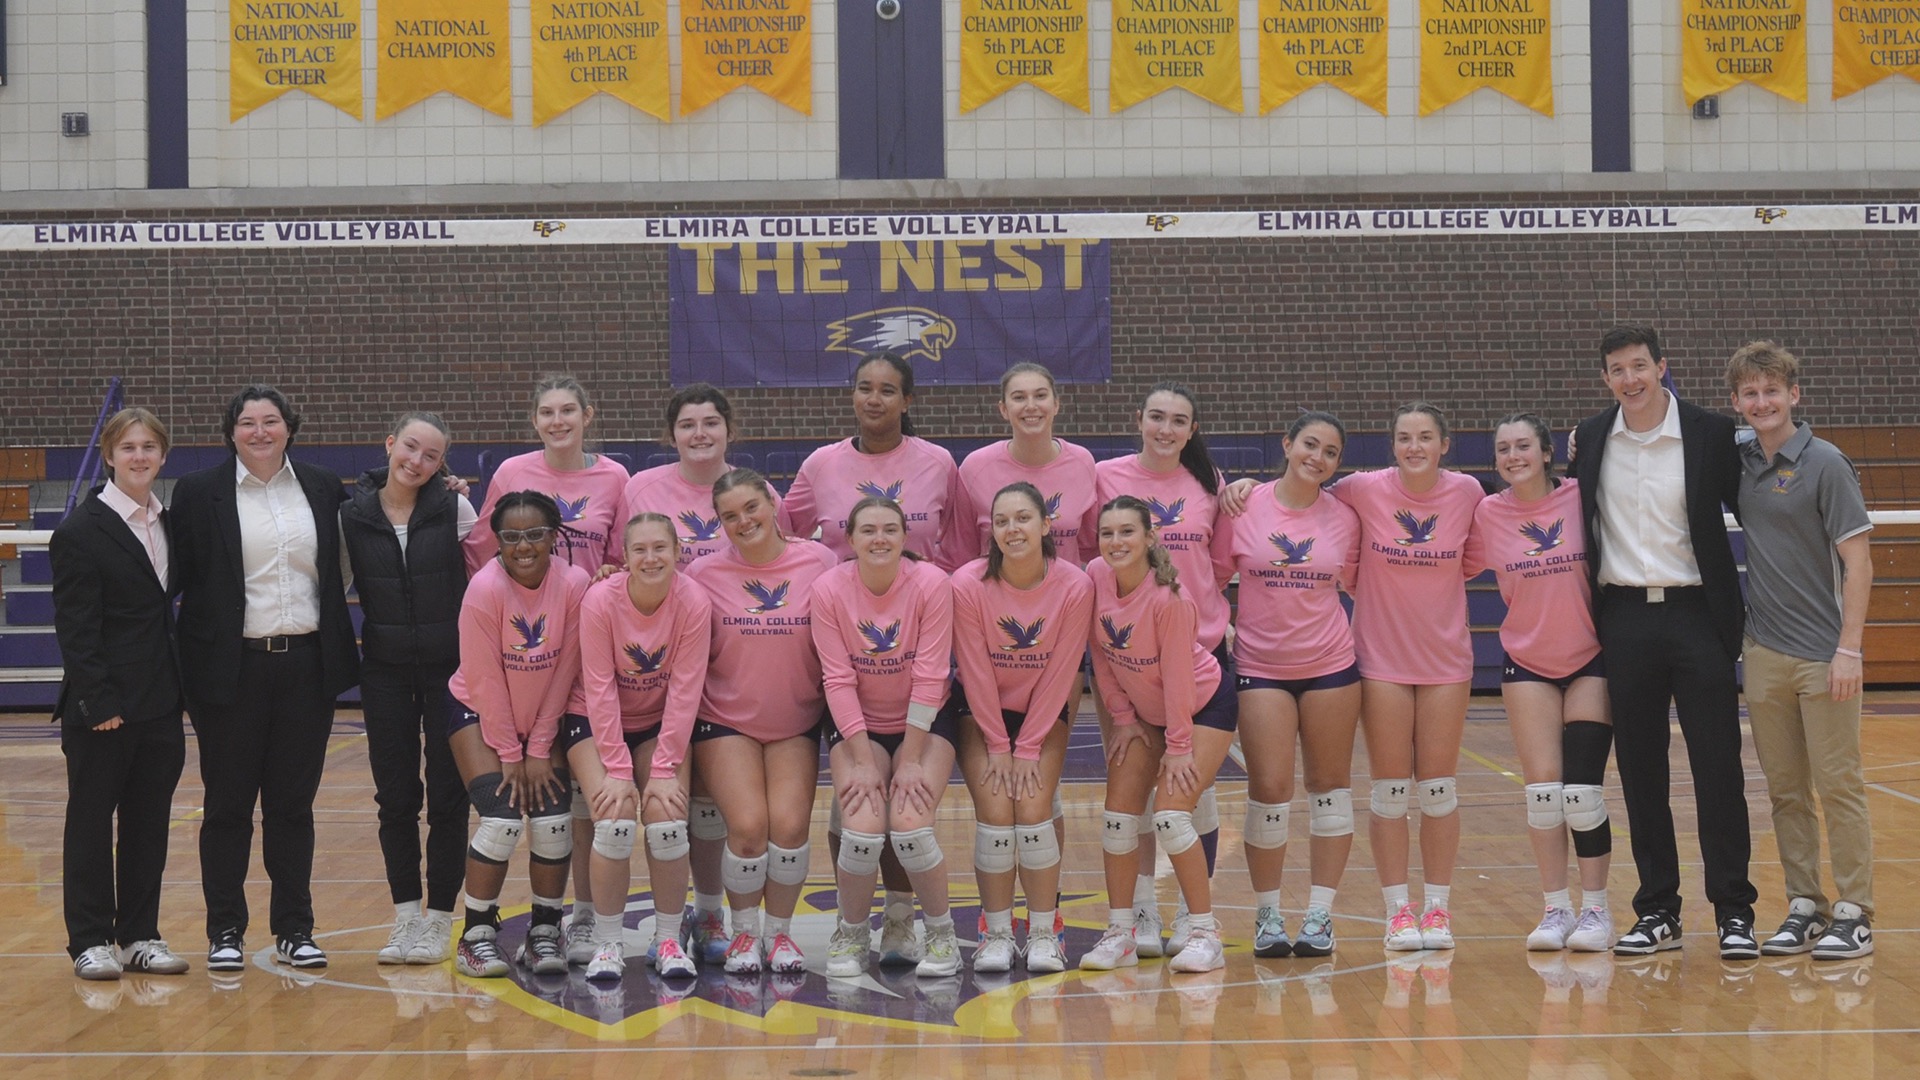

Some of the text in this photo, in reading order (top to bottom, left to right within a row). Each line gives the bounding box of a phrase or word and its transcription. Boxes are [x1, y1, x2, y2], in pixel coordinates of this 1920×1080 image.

[246, 2, 344, 20] NATIONAL
[552, 1, 645, 20] NATIONAL
[1131, 0, 1223, 12] NATIONAL
[1442, 0, 1533, 13] NATIONAL
[1687, 14, 1801, 31] CHAMPIONSHIP
[1839, 6, 1920, 23] CHAMPION
[234, 23, 356, 41] CHAMPIONSHIP
[395, 20, 490, 37] NATIONAL
[540, 22, 660, 41] CHAMPIONSHIP
[685, 15, 806, 33] CHAMPIONSHIP
[964, 15, 1083, 33] CHAMPIONSHIP
[1117, 17, 1234, 34] CHAMPIONSHIP
[1263, 17, 1384, 33] CHAMPIONSHIP
[1426, 19, 1546, 35] CHAMPIONSHIP
[1705, 37, 1784, 52] 3rd PLACE
[1857, 29, 1920, 45] 3rd PLA
[388, 42, 495, 59] CHAMPIONS
[704, 38, 789, 55] 10th PLACE
[983, 38, 1065, 54] 5th PLACE
[1135, 40, 1215, 56] 4th PLACE
[1283, 39, 1364, 55] 4th PLACE
[1444, 41, 1527, 57] 2nd PLACE
[256, 46, 336, 64] 7th PLACE
[563, 45, 637, 64] 4th PLACE
[717, 60, 774, 77] CHEER
[996, 59, 1053, 76] CHEER
[1147, 61, 1204, 77] CHEER
[1296, 60, 1353, 76] CHEER
[1458, 62, 1514, 78] CHEER
[1716, 58, 1773, 74] CHEER
[265, 69, 327, 85] CHEER
[571, 66, 629, 83] CHEER
[1258, 208, 1677, 230] ELMIRA COLLEGE VOLLEYBALL
[1865, 206, 1918, 224] ELM
[34, 221, 454, 243] ELMIRA COLLEGE VOLLEYBALL
[645, 215, 1068, 237] ELMIRA COLLEGE VOLLEYBALL
[678, 239, 1101, 295] THE NEST
[905, 513, 928, 521] LEGE
[1371, 542, 1457, 559] ELMIRA COLLEGE
[1387, 558, 1438, 567] VOLLEYBALL
[1506, 560, 1541, 572] ELMIRA
[1249, 569, 1333, 581] ELMIRA COLLEGE
[1522, 566, 1573, 578] VOLLEYBALL
[1265, 581, 1315, 589] VOLLEYBALL
[723, 617, 761, 626] ELMIRA
[502, 653, 524, 663] MIRA
[991, 652, 1052, 661] MIRA COLLE
[505, 662, 552, 671] VOLLEYBALL
